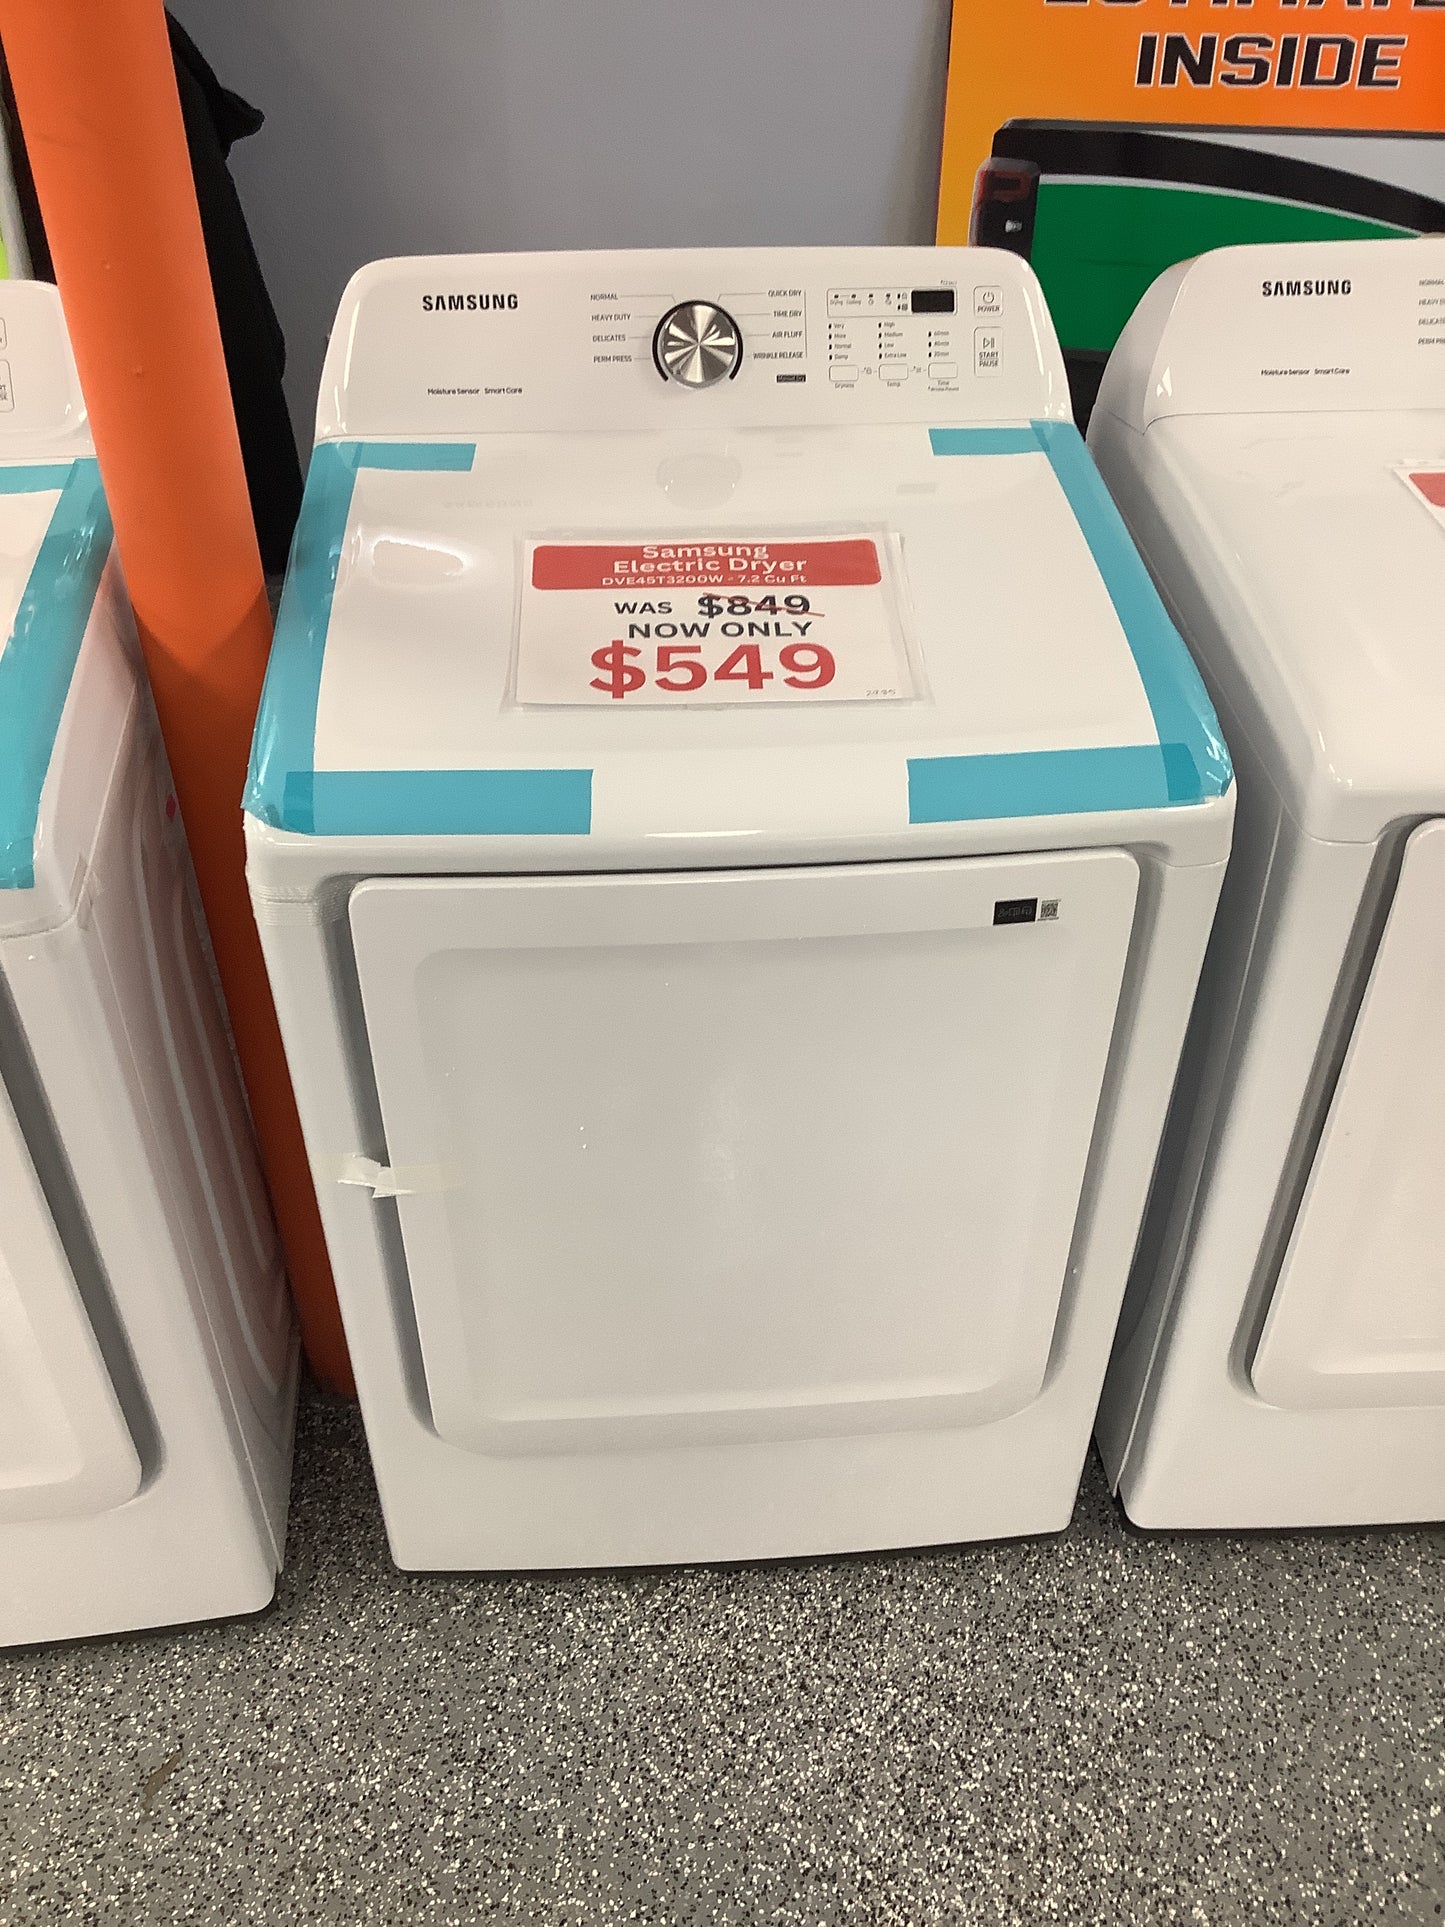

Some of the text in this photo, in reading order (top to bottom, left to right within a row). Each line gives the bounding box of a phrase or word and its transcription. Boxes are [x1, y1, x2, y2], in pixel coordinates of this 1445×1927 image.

[1134, 32, 1408, 89] INSIDE
[1261, 279, 1352, 297] SAMSUNG
[590, 292, 619, 301] NORMAL
[767, 289, 802, 297] QUICK DRY
[422, 293, 519, 312] SAMSUNG
[591, 313, 631, 321] HEAVY DUTY
[773, 310, 788, 318] TIME
[592, 334, 626, 343] DELICATES
[771, 330, 803, 338] AIR FLUFF
[593, 355, 632, 363] PERM PRESS
[752, 351, 803, 360] WRINKLE RELEASE
[979, 351, 999, 359] START
[979, 360, 999, 368] PAUSE
[1288, 368, 1310, 376] Sensor
[1314, 367, 1334, 375] Smart
[1334, 367, 1351, 375] Care
[427, 387, 523, 396] Moisture Sensor Smart Care
[642, 544, 769, 560] Samsung
[613, 557, 807, 575] Electric Dryer
[602, 574, 724, 586] DVE45T3200W
[739, 574, 760, 584] 7.2
[764, 574, 785, 584] Cu
[790, 574, 807, 583] Ft
[614, 594, 811, 619] WAS $849
[627, 620, 813, 639] NOW ONLY
[589, 639, 836, 699] $549
